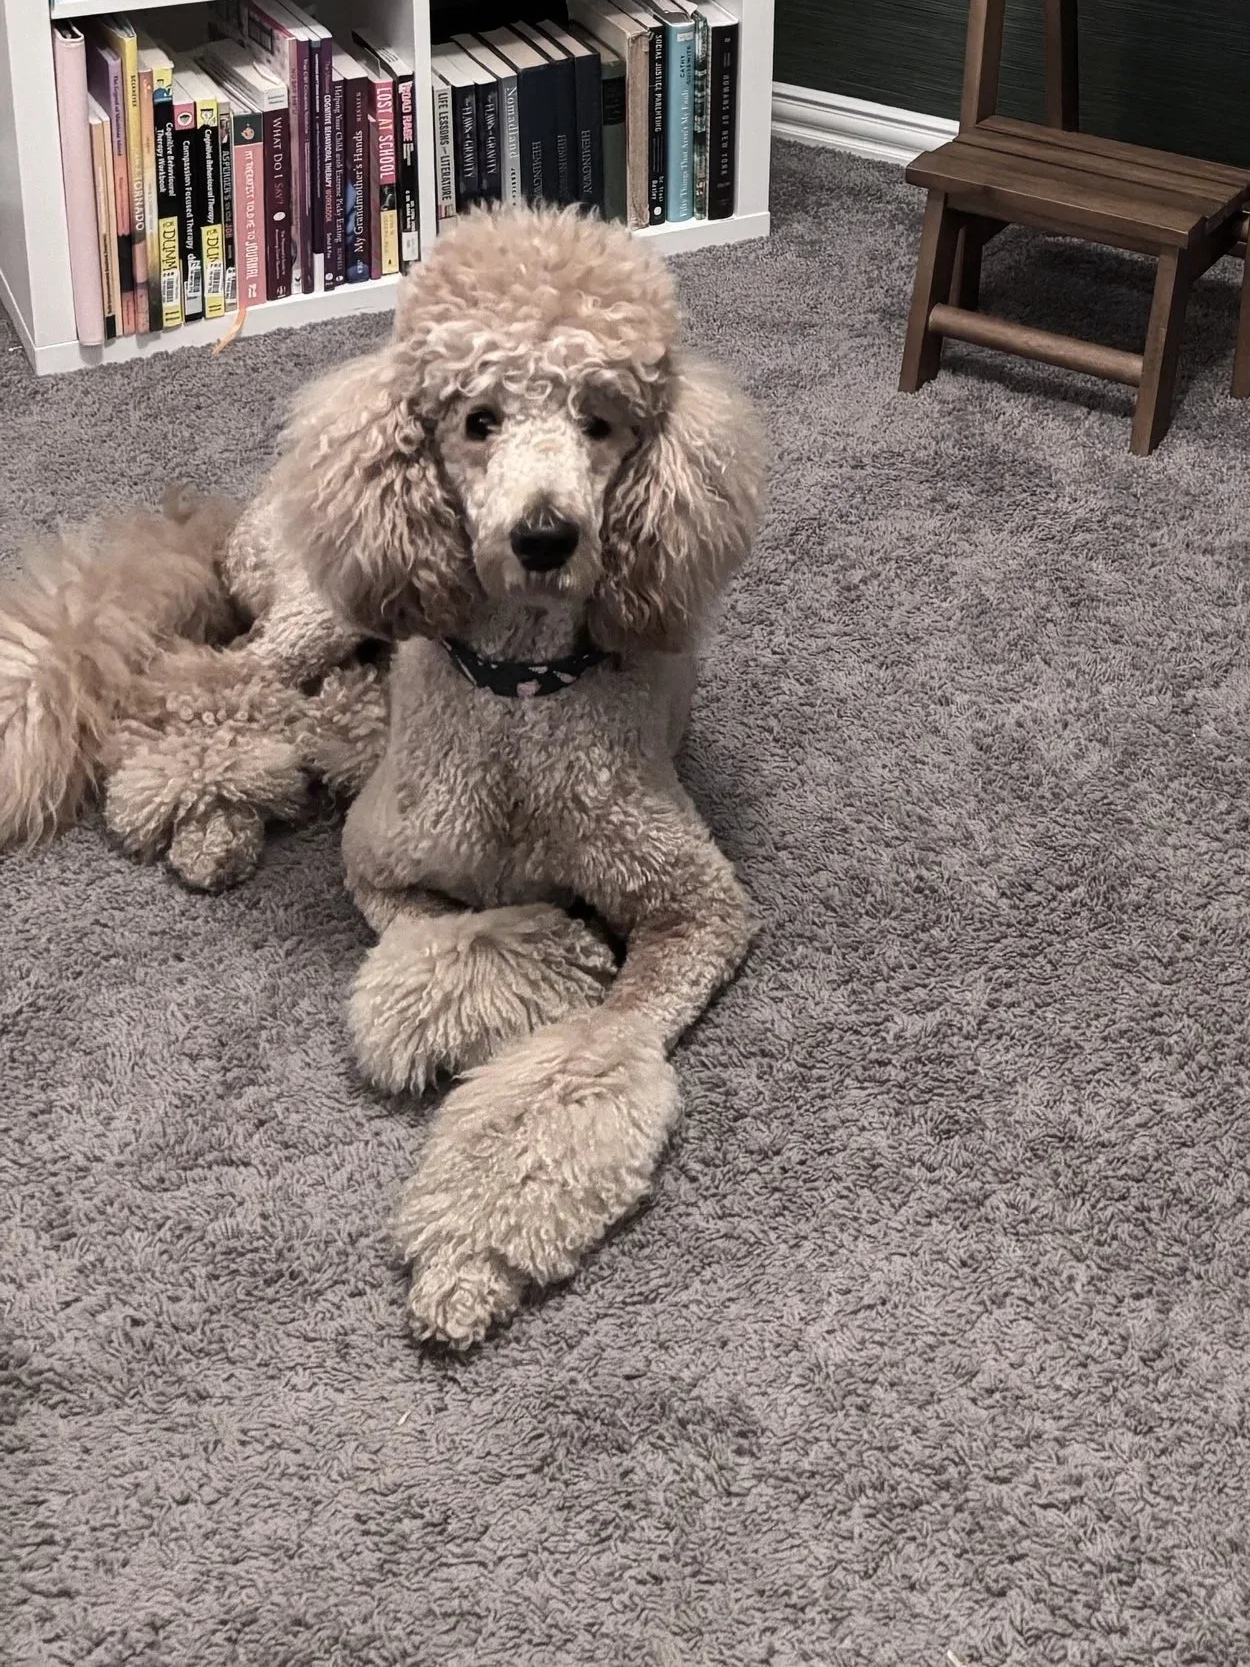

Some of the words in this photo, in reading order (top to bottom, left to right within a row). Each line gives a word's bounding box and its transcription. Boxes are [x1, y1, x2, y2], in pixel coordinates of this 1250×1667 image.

[655, 35, 663, 60] SOCIAL
[332, 85, 343, 113] Helping
[377, 87, 393, 114] LOST
[438, 92, 449, 109] LIFE
[722, 74, 730, 110] HUMANS
[324, 94, 332, 126] COGNITIVE
[378, 118, 393, 130] AT
[462, 106, 474, 133] FLAWS
[485, 103, 496, 130] FLAWS
[507, 86, 519, 158] Nomadland
[722, 115, 729, 124] OF
[156, 129, 164, 157] Therapy
[165, 122, 173, 155] Cognitive
[273, 117, 283, 150] WHAT
[335, 132, 344, 151] Child
[439, 111, 450, 145] LESSONS
[204, 129, 213, 159] Cognitive
[324, 126, 332, 162] BEHAVIORAL
[353, 130, 363, 162] Hands
[379, 135, 395, 179] SCHOOL
[464, 140, 475, 178] GRAVITY
[487, 136, 497, 175] GRAVITY
[158, 158, 167, 192] Workbook
[182, 140, 192, 186] Compassion
[274, 154, 283, 171] DO
[581, 130, 592, 194] HEMINGWAY
[336, 170, 344, 197] Extreme
[441, 155, 451, 201] LITERATURE
[185, 187, 193, 217] Focused
[207, 198, 216, 224] Therapy
[335, 198, 344, 216] Picky
[353, 164, 364, 235] Grandmother's
[186, 218, 194, 249] Therapy
[334, 218, 344, 243] Eating
[354, 237, 366, 252] My
[246, 242, 259, 280] JOURNAL
